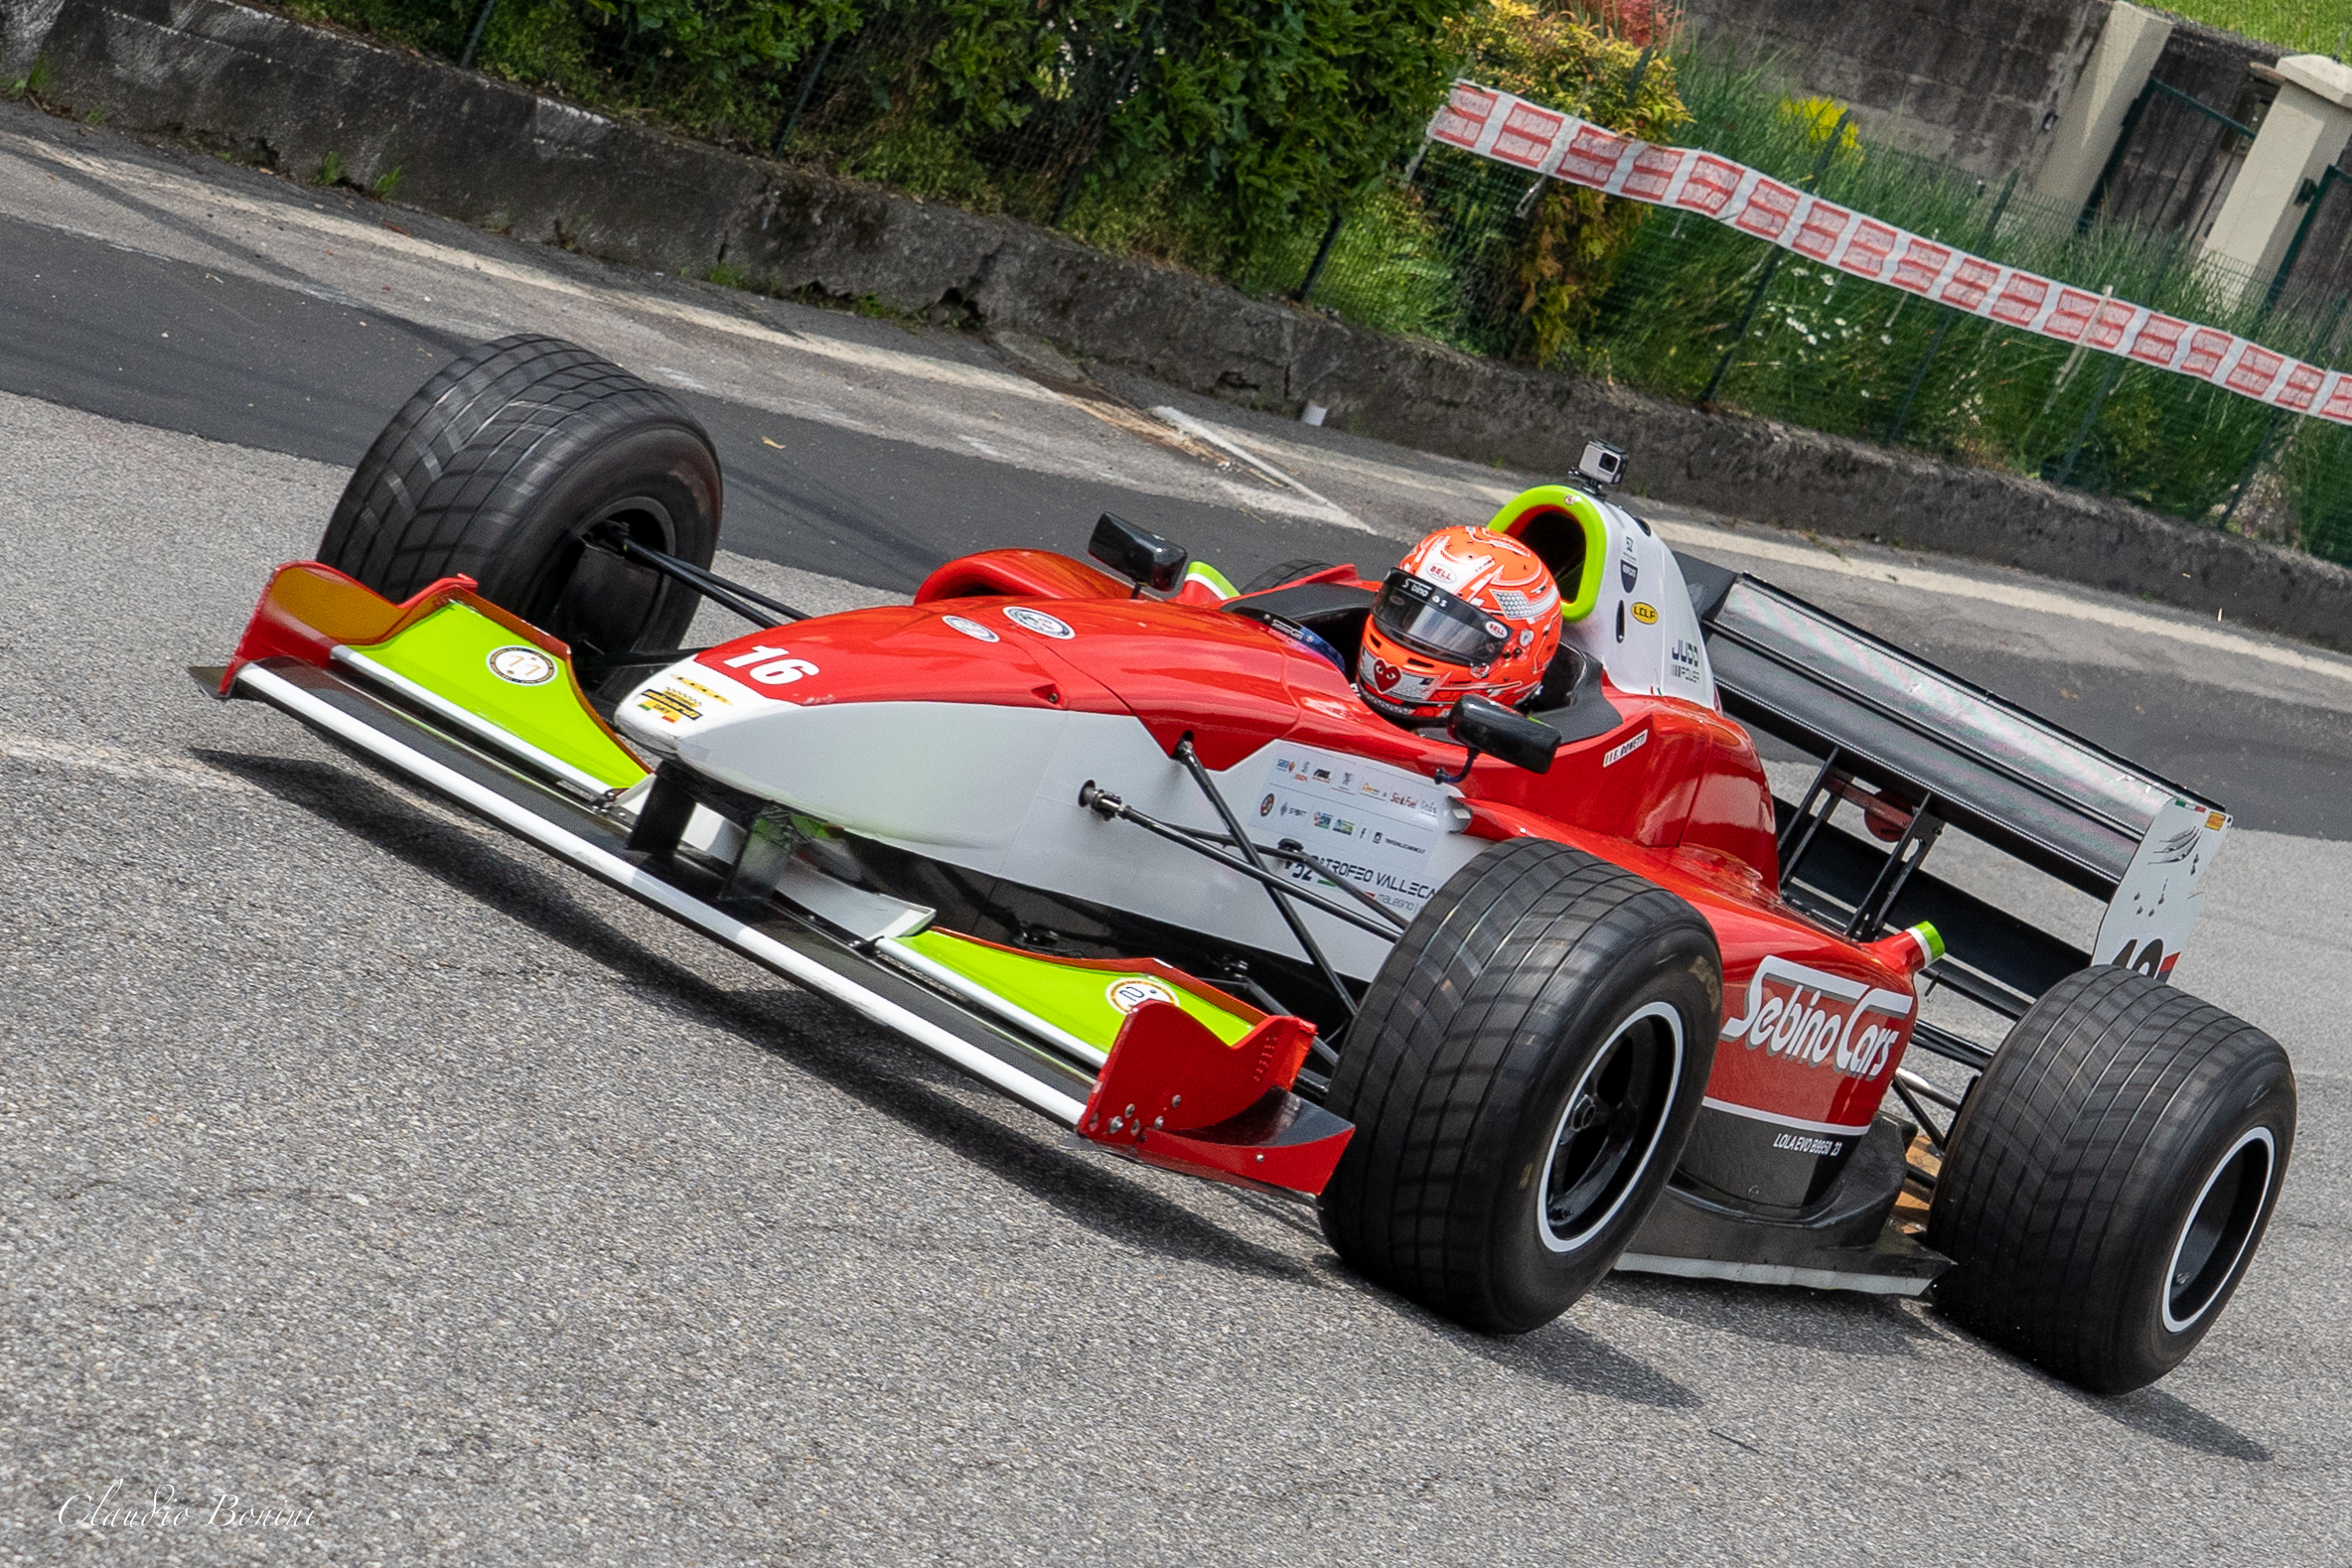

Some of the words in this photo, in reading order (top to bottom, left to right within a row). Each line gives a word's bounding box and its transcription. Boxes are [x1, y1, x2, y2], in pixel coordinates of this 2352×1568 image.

[1429, 565, 1451, 581] BELL
[723, 643, 820, 685] 16
[1326, 857, 1375, 883] TROFEO
[1720, 954, 1870, 1068] Sebino
[1835, 987, 1914, 1082] Cars
[1772, 1133, 1797, 1150] LOLA
[1793, 1136, 1814, 1153] EVO
